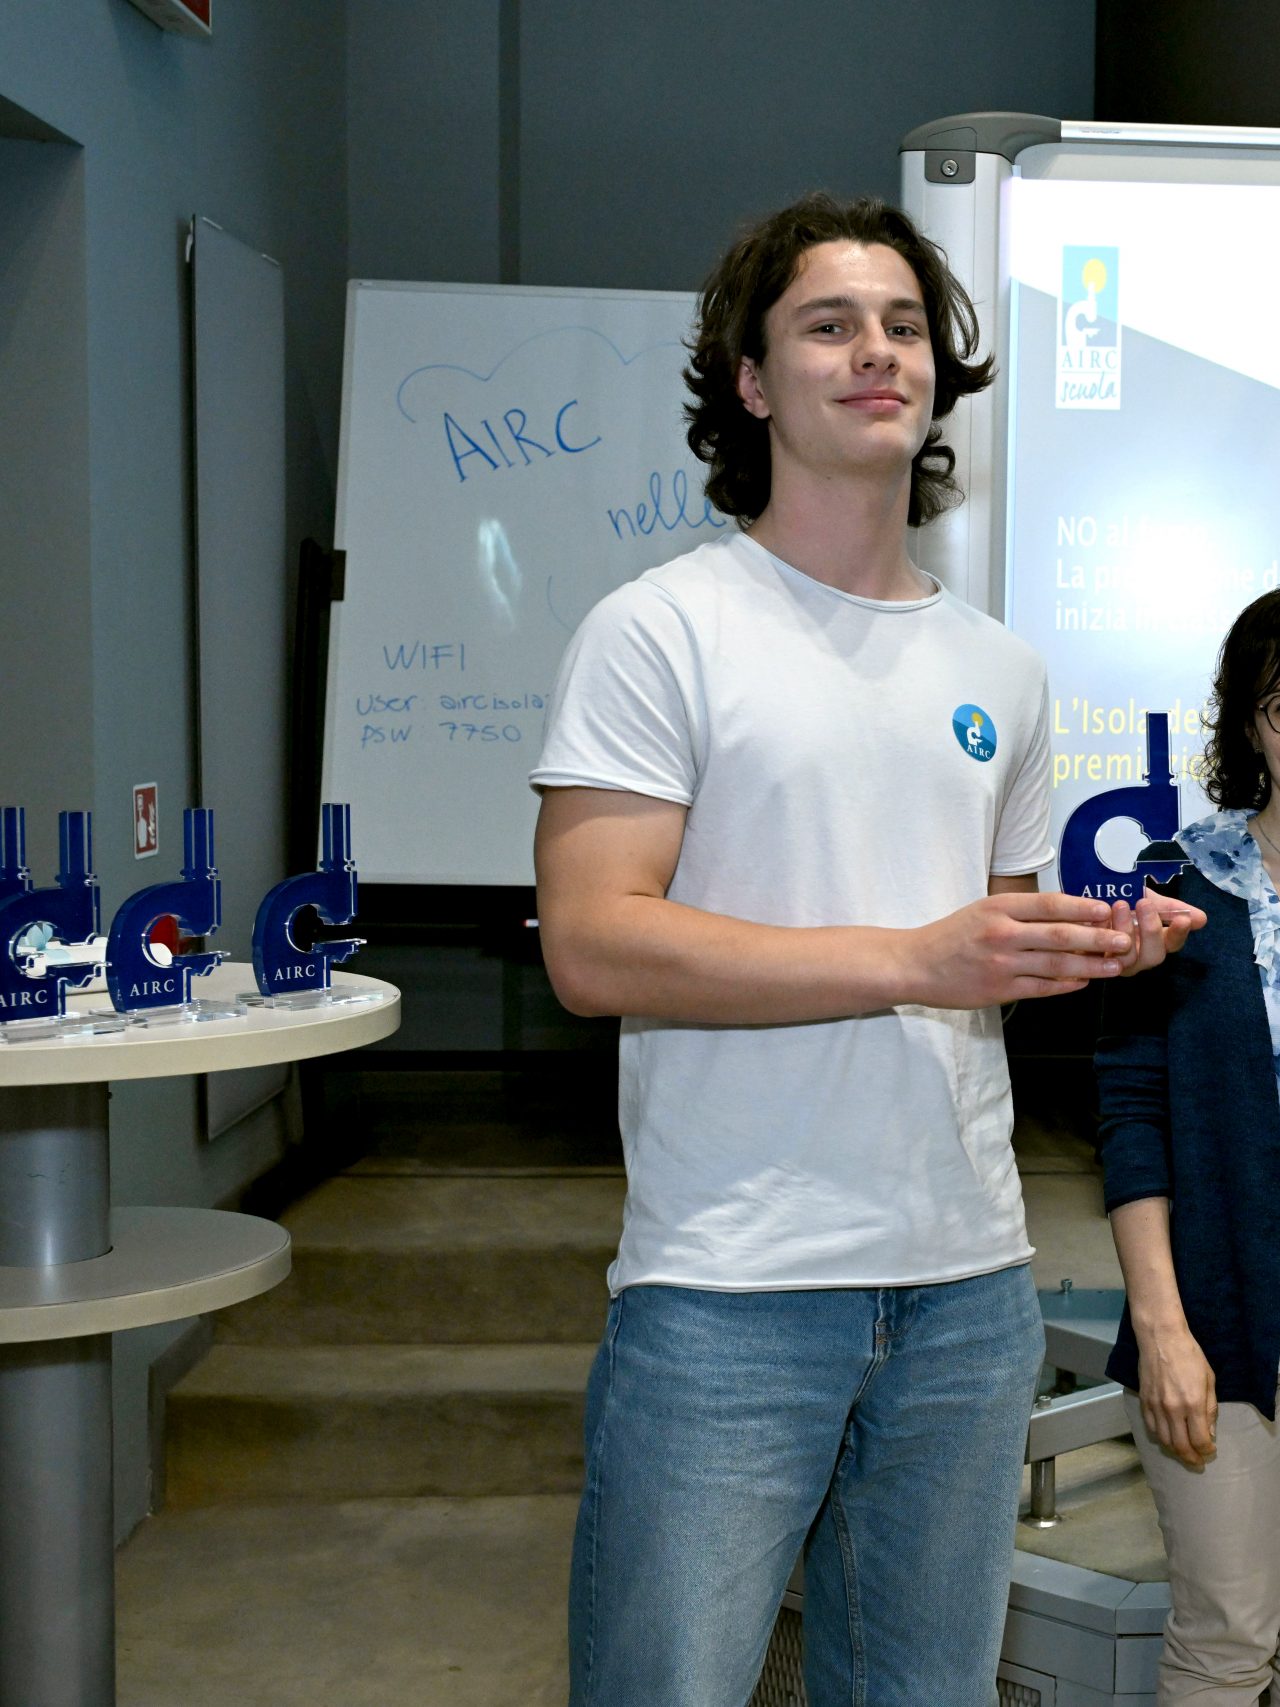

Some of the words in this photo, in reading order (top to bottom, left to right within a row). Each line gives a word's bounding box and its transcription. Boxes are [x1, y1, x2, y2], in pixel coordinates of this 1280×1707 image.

[1061, 350, 1117, 369] AIRC
[1061, 371, 1117, 402] scuola
[443, 400, 602, 482] AIRC
[1057, 516, 1097, 547] NO
[1104, 512, 1130, 547] al
[1056, 559, 1085, 589] La
[1056, 602, 1128, 631] inizia
[383, 640, 465, 671] WIFI
[439, 722, 522, 743] 7750
[966, 744, 991, 760] AIRC
[1082, 883, 1134, 898] AIRC
[273, 964, 315, 981] AIRC
[0, 989, 48, 1008] AIRC
[130, 979, 175, 997] AIRC
